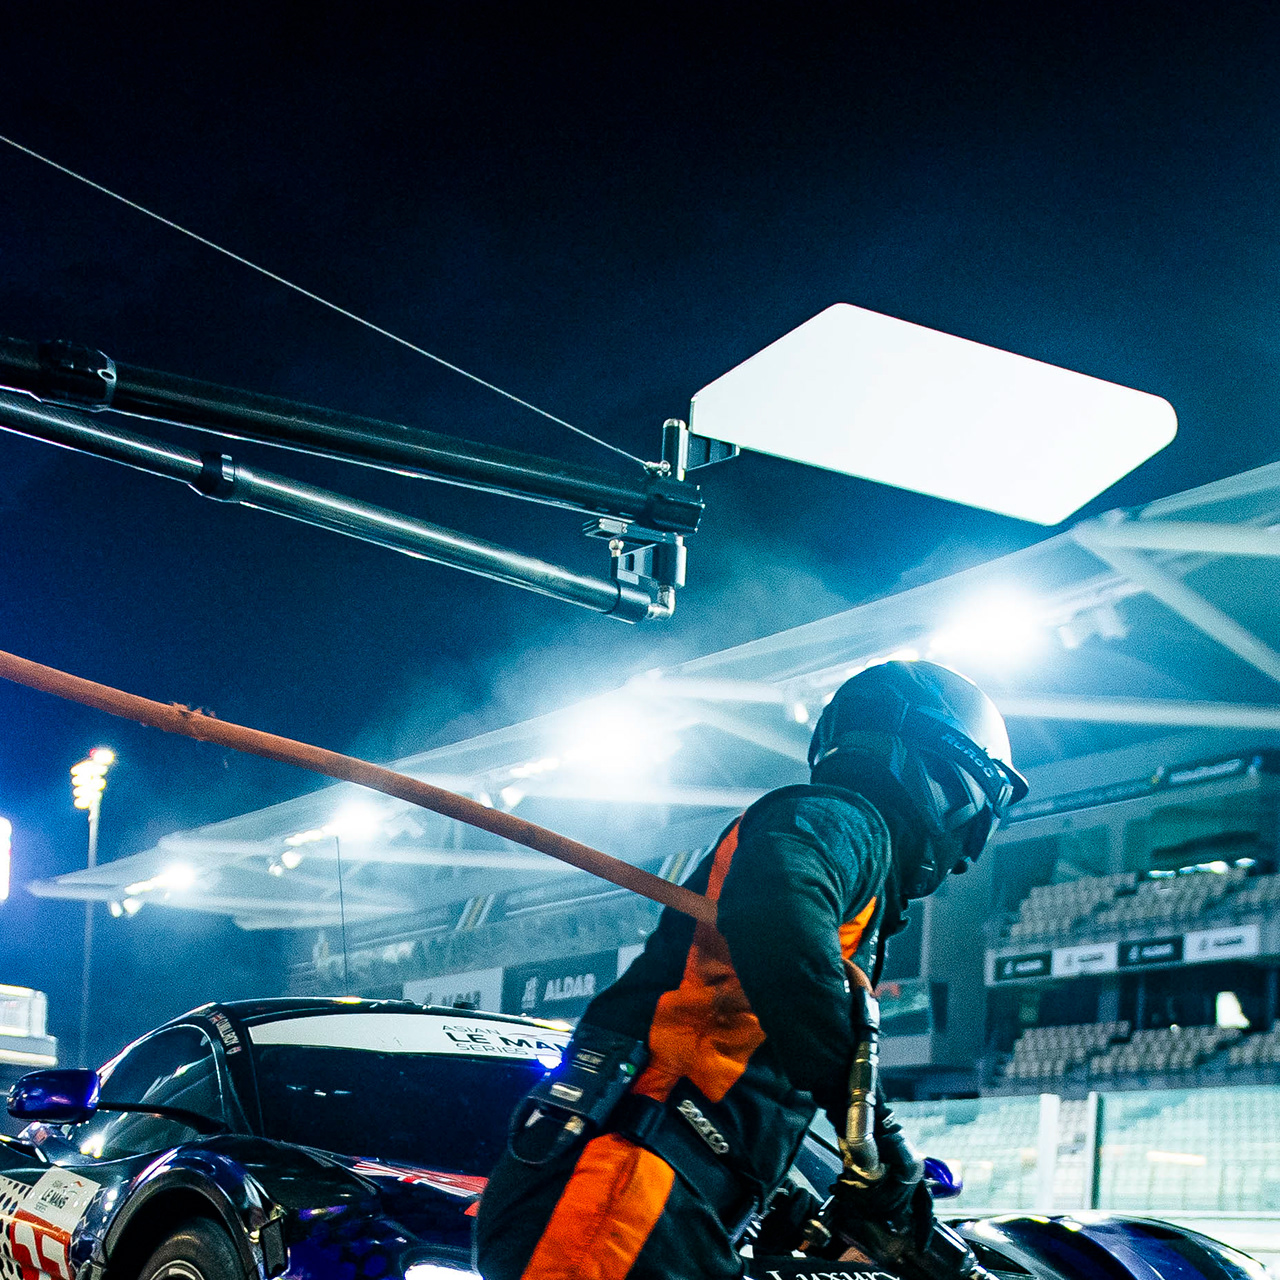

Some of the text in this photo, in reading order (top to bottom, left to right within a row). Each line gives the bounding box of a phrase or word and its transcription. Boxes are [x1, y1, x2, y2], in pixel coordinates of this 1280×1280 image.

[442, 1024, 502, 1036] ASIAN
[446, 1031, 491, 1045] LE
[456, 1042, 529, 1056] SERIES
